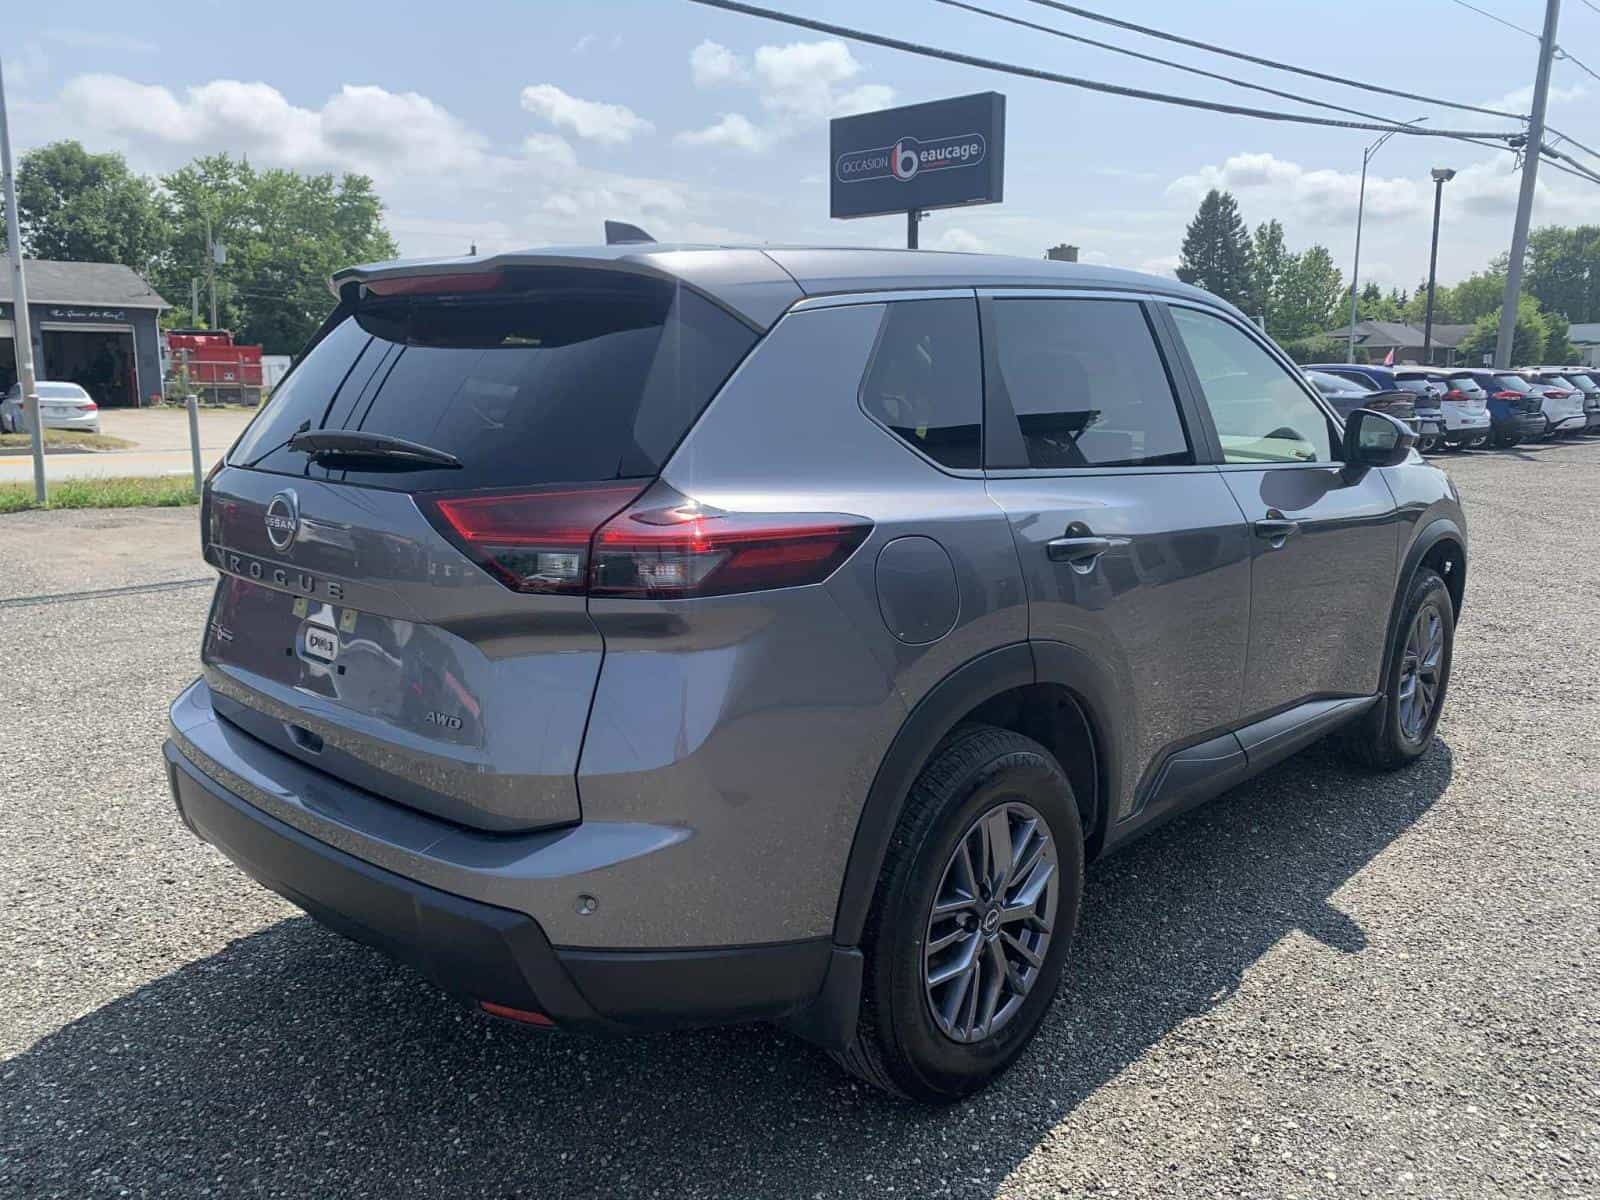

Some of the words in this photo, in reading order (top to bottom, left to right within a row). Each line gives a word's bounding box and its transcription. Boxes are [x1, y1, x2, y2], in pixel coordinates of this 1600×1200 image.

[842, 155, 888, 174] OCCASION
[265, 516, 296, 531] NISSAN
[229, 554, 344, 600] ROGUE
[424, 711, 463, 729] AWD
